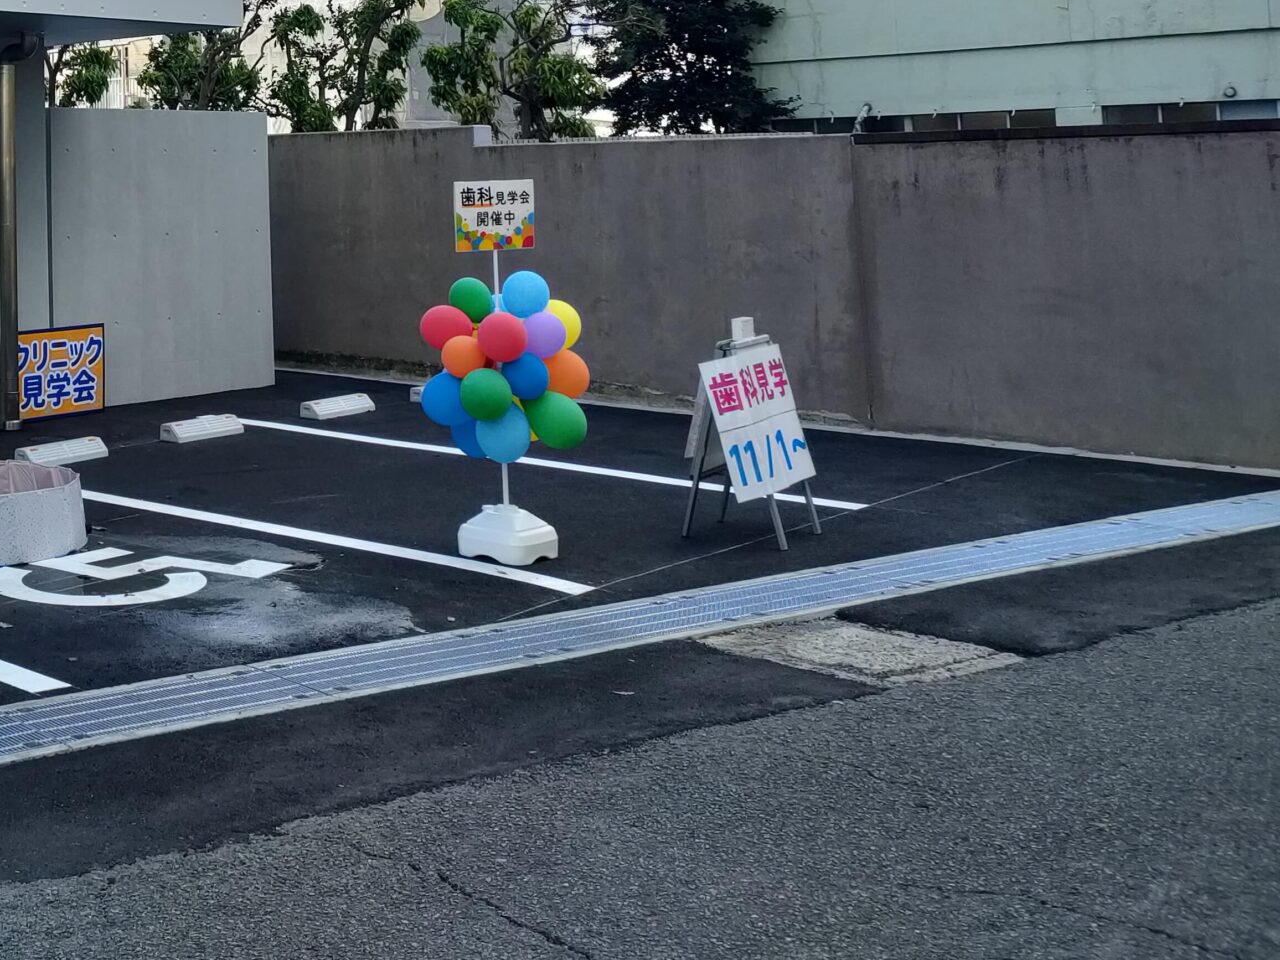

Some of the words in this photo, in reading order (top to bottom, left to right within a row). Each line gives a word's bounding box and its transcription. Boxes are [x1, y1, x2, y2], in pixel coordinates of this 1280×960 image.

[460, 185, 531, 207] 歯科見学会
[476, 209, 516, 227] 開催中
[18, 335, 102, 372] クリニック
[21, 369, 96, 410] 見学会
[708, 357, 789, 416] 歯科見学
